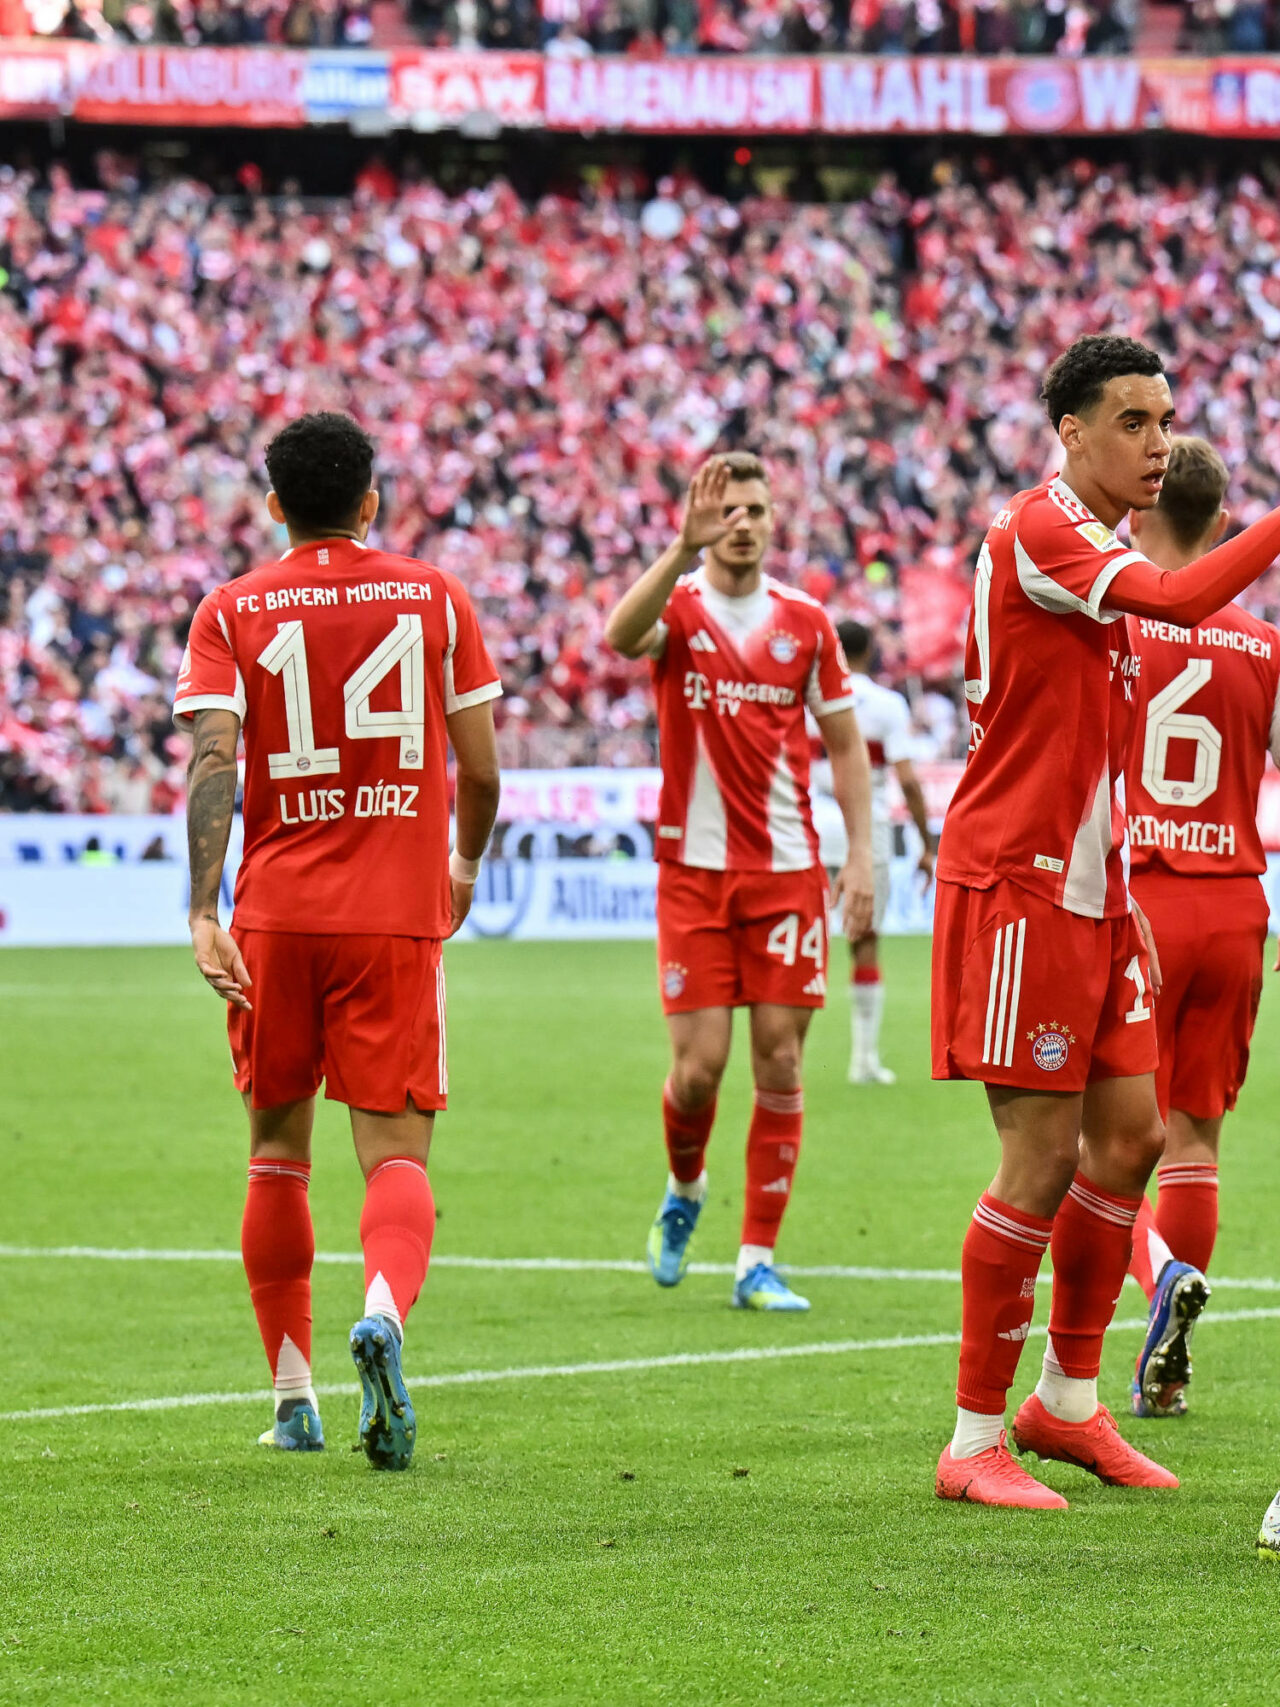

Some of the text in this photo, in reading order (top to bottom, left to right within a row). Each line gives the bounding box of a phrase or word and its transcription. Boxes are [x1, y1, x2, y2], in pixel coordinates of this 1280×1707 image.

[236, 582, 432, 613] FC BAYERN MÜNCHEN
[256, 614, 424, 780] 14
[717, 697, 741, 717] TV
[1141, 658, 1222, 807] 6
[279, 779, 419, 825] LUIS DÍAZ
[1129, 814, 1236, 856] KIMMICH
[766, 913, 824, 969] 44
